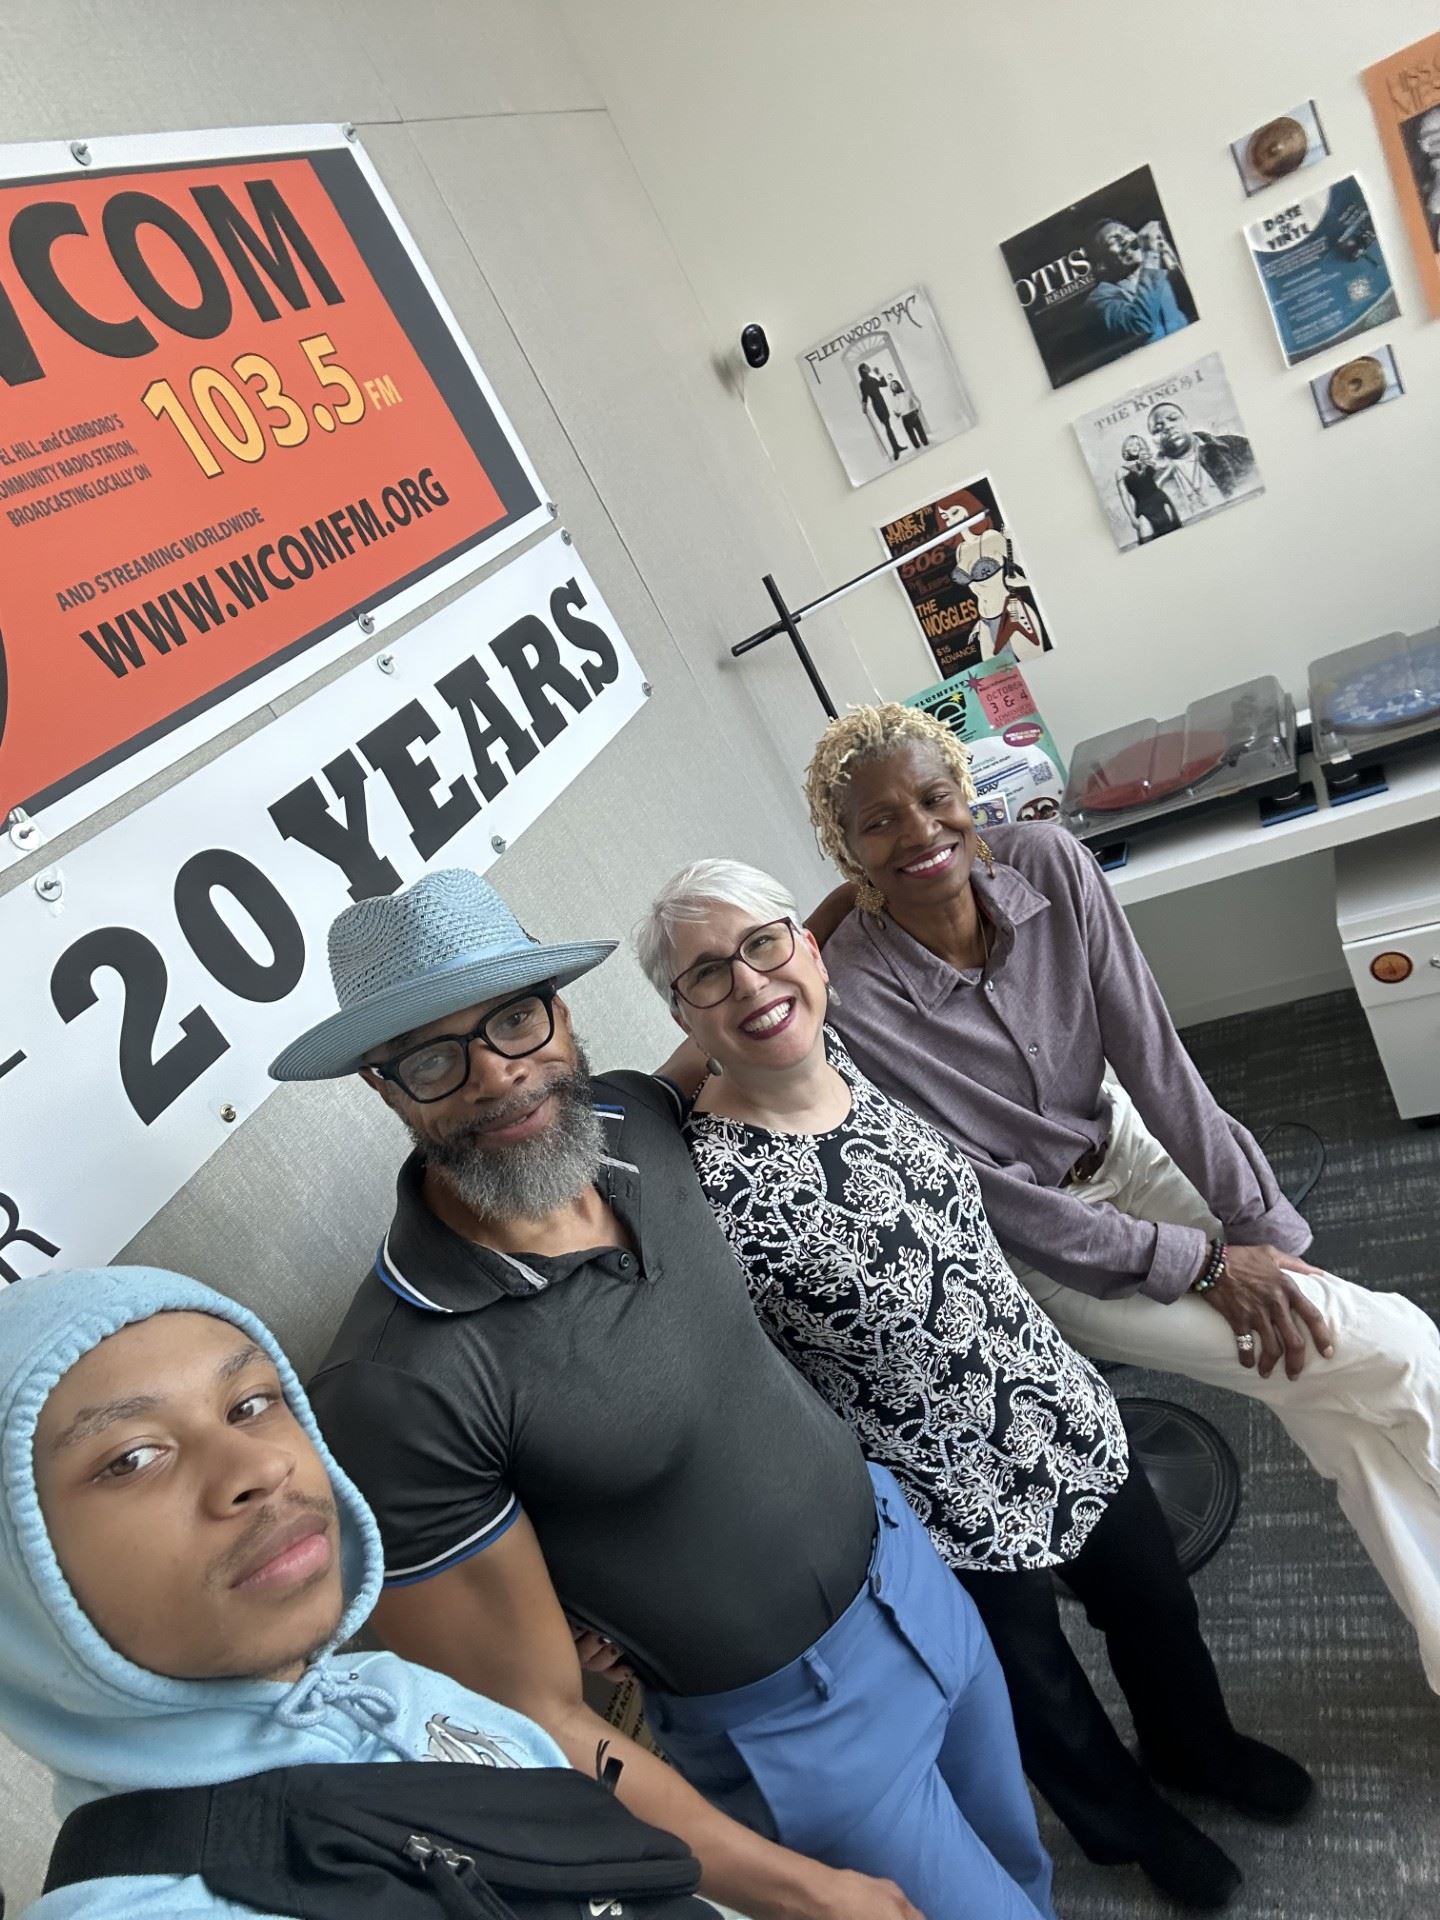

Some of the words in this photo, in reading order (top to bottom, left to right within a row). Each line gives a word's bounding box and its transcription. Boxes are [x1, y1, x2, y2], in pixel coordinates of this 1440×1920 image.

[1262, 204, 1303, 232] DOSE
[1014, 247, 1092, 307] OTIS
[1044, 274, 1096, 305] REDDING
[804, 316, 882, 384] FLEETWOOD
[881, 294, 923, 328] MAC
[140, 332, 366, 479] 103.5
[363, 374, 404, 411] FM
[1094, 407, 1130, 429] THE
[10, 440, 42, 461] HILL
[38, 432, 62, 453] and
[58, 413, 125, 446] CARRBORO'S
[0, 463, 60, 500] OMMUNITY
[56, 452, 95, 478] RADIO
[90, 439, 139, 466] STATION,
[6, 482, 96, 528] BROADCASTING
[90, 468, 136, 496] LOCALLY
[133, 463, 153, 481] ON
[885, 514, 916, 539] JUNE
[887, 524, 926, 547] FRIDAY
[55, 579, 96, 612] AND
[95, 542, 184, 596] STREAMING
[179, 506, 265, 555] WORLDWIDE
[79, 467, 451, 679] WWW.WCOMFM.ORG
[901, 547, 945, 579] 506
[915, 598, 938, 618] THE
[921, 599, 978, 637] WOGGLES
[940, 644, 977, 665] ADVANCE
[986, 681, 1023, 702] OCTOBER
[989, 702, 999, 714] 3
[1003, 695, 1015, 707] &
[1020, 688, 1029, 701] 4
[50, 848, 305, 1126] 20
[267, 576, 619, 904] YEARS
